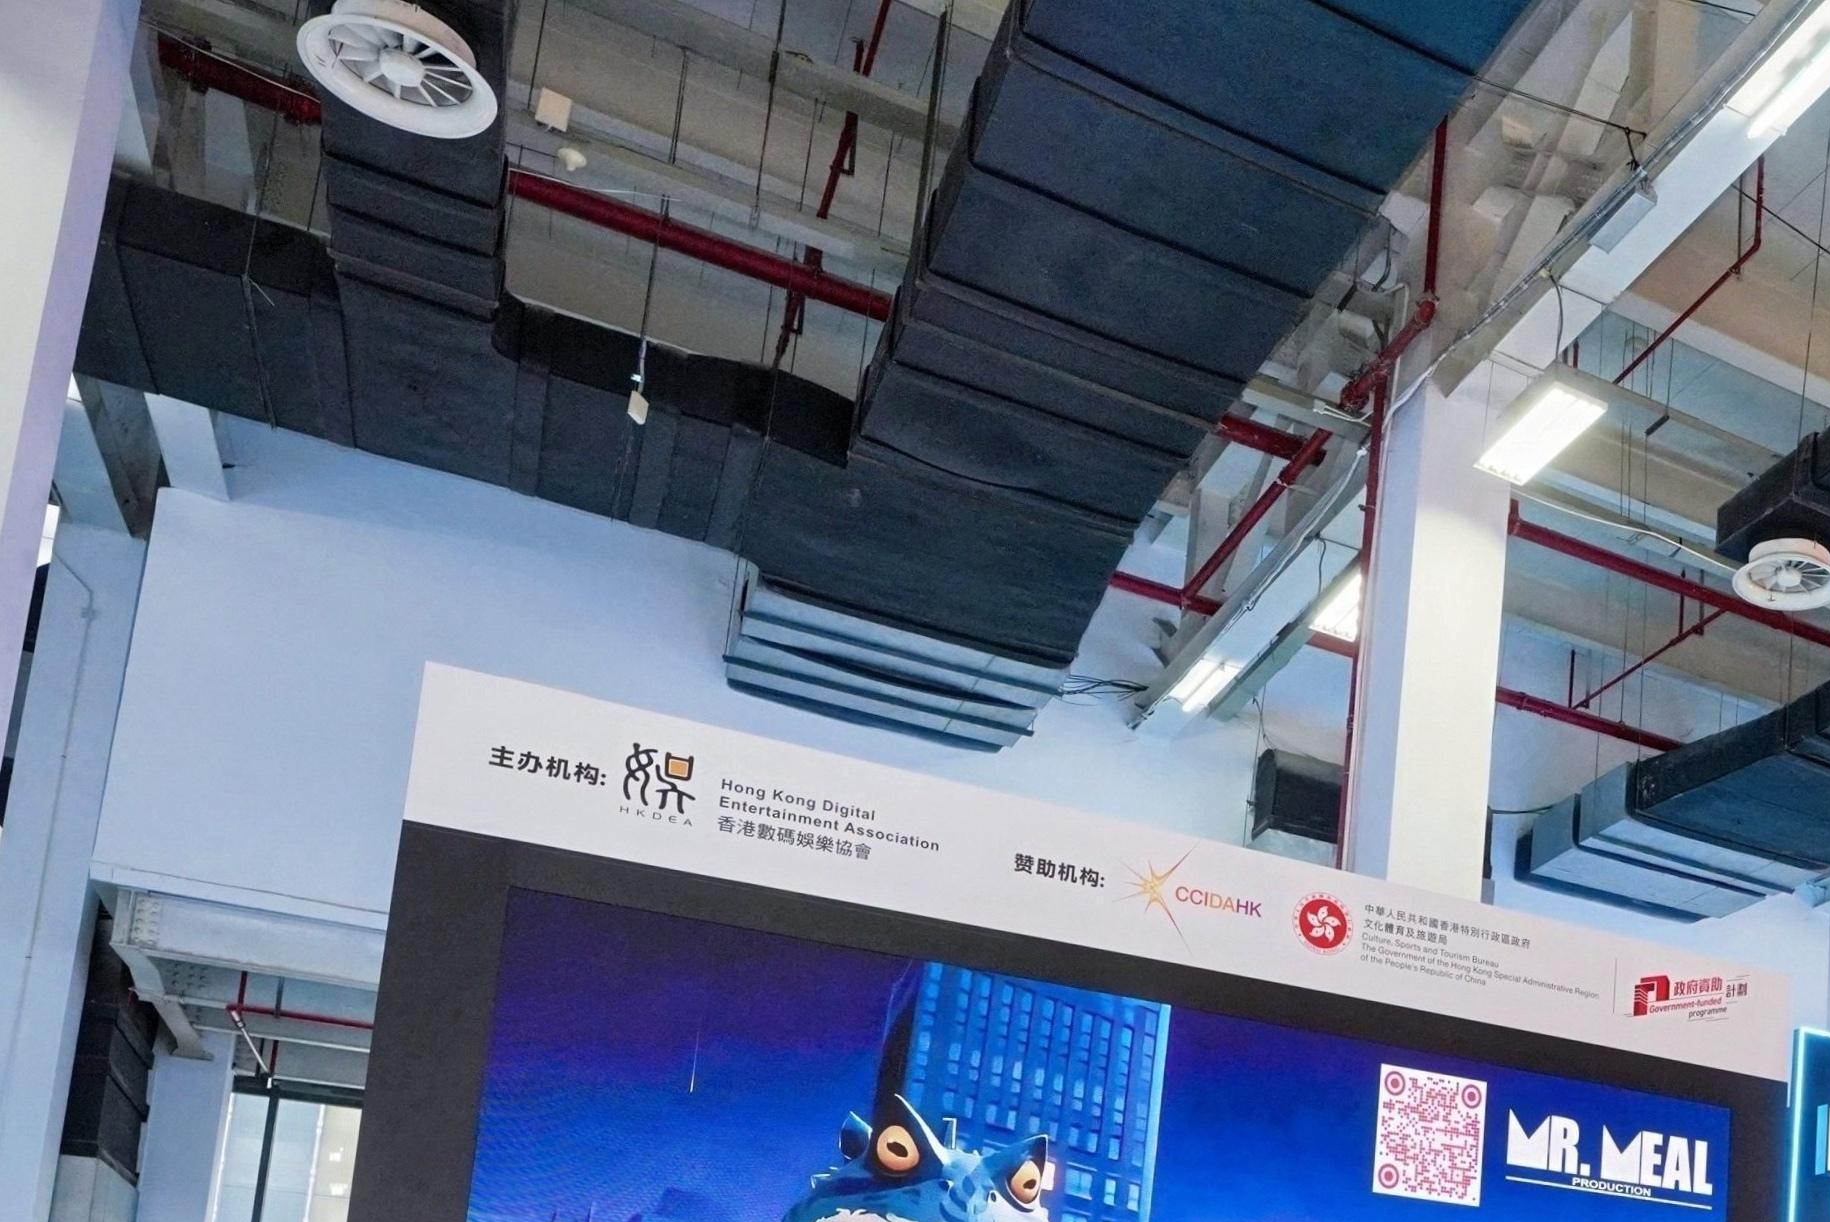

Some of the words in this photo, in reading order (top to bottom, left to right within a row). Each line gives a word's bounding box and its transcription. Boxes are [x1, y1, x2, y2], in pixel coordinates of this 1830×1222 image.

[489, 746, 606, 786] 主办机构:
[620, 806, 693, 827] HKDEA
[721, 778, 766, 801] Hong
[772, 789, 816, 811] Kong
[822, 800, 876, 821] Digital
[717, 815, 872, 861] 香港數碼娛樂協會
[719, 796, 839, 831] Entertainment
[843, 822, 940, 852] Association
[1014, 853, 1105, 888] 赞助机构:
[1175, 886, 1262, 918] CCIDAHK
[1361, 932, 1393, 946] Culture,
[1394, 939, 1421, 952] Sports
[1422, 945, 1438, 955] and
[1440, 949, 1470, 961] Tourism
[1472, 955, 1499, 968] Bureau
[1362, 942, 1376, 952] The
[1377, 945, 1426, 963] Government
[1436, 958, 1450, 967] the
[1450, 960, 1471, 973] Hong
[1472, 966, 1493, 978] Kong
[1493, 970, 1521, 983] Special
[1522, 976, 1574, 994] Administrative
[1574, 987, 1600, 1000] Region
[1370, 954, 1384, 964] the
[1385, 957, 1419, 972] People's
[1419, 965, 1453, 979] Republic
[1464, 974, 1486, 986] China
[1673, 976, 1723, 997] 政府資助
[1649, 997, 1723, 1014] Government-funded
[1688, 1006, 1728, 1019] programme
[1506, 1108, 1591, 1177] MR.
[1600, 1124, 1713, 1196] MEAL
[1571, 1176, 1652, 1198] PRODUCTION
